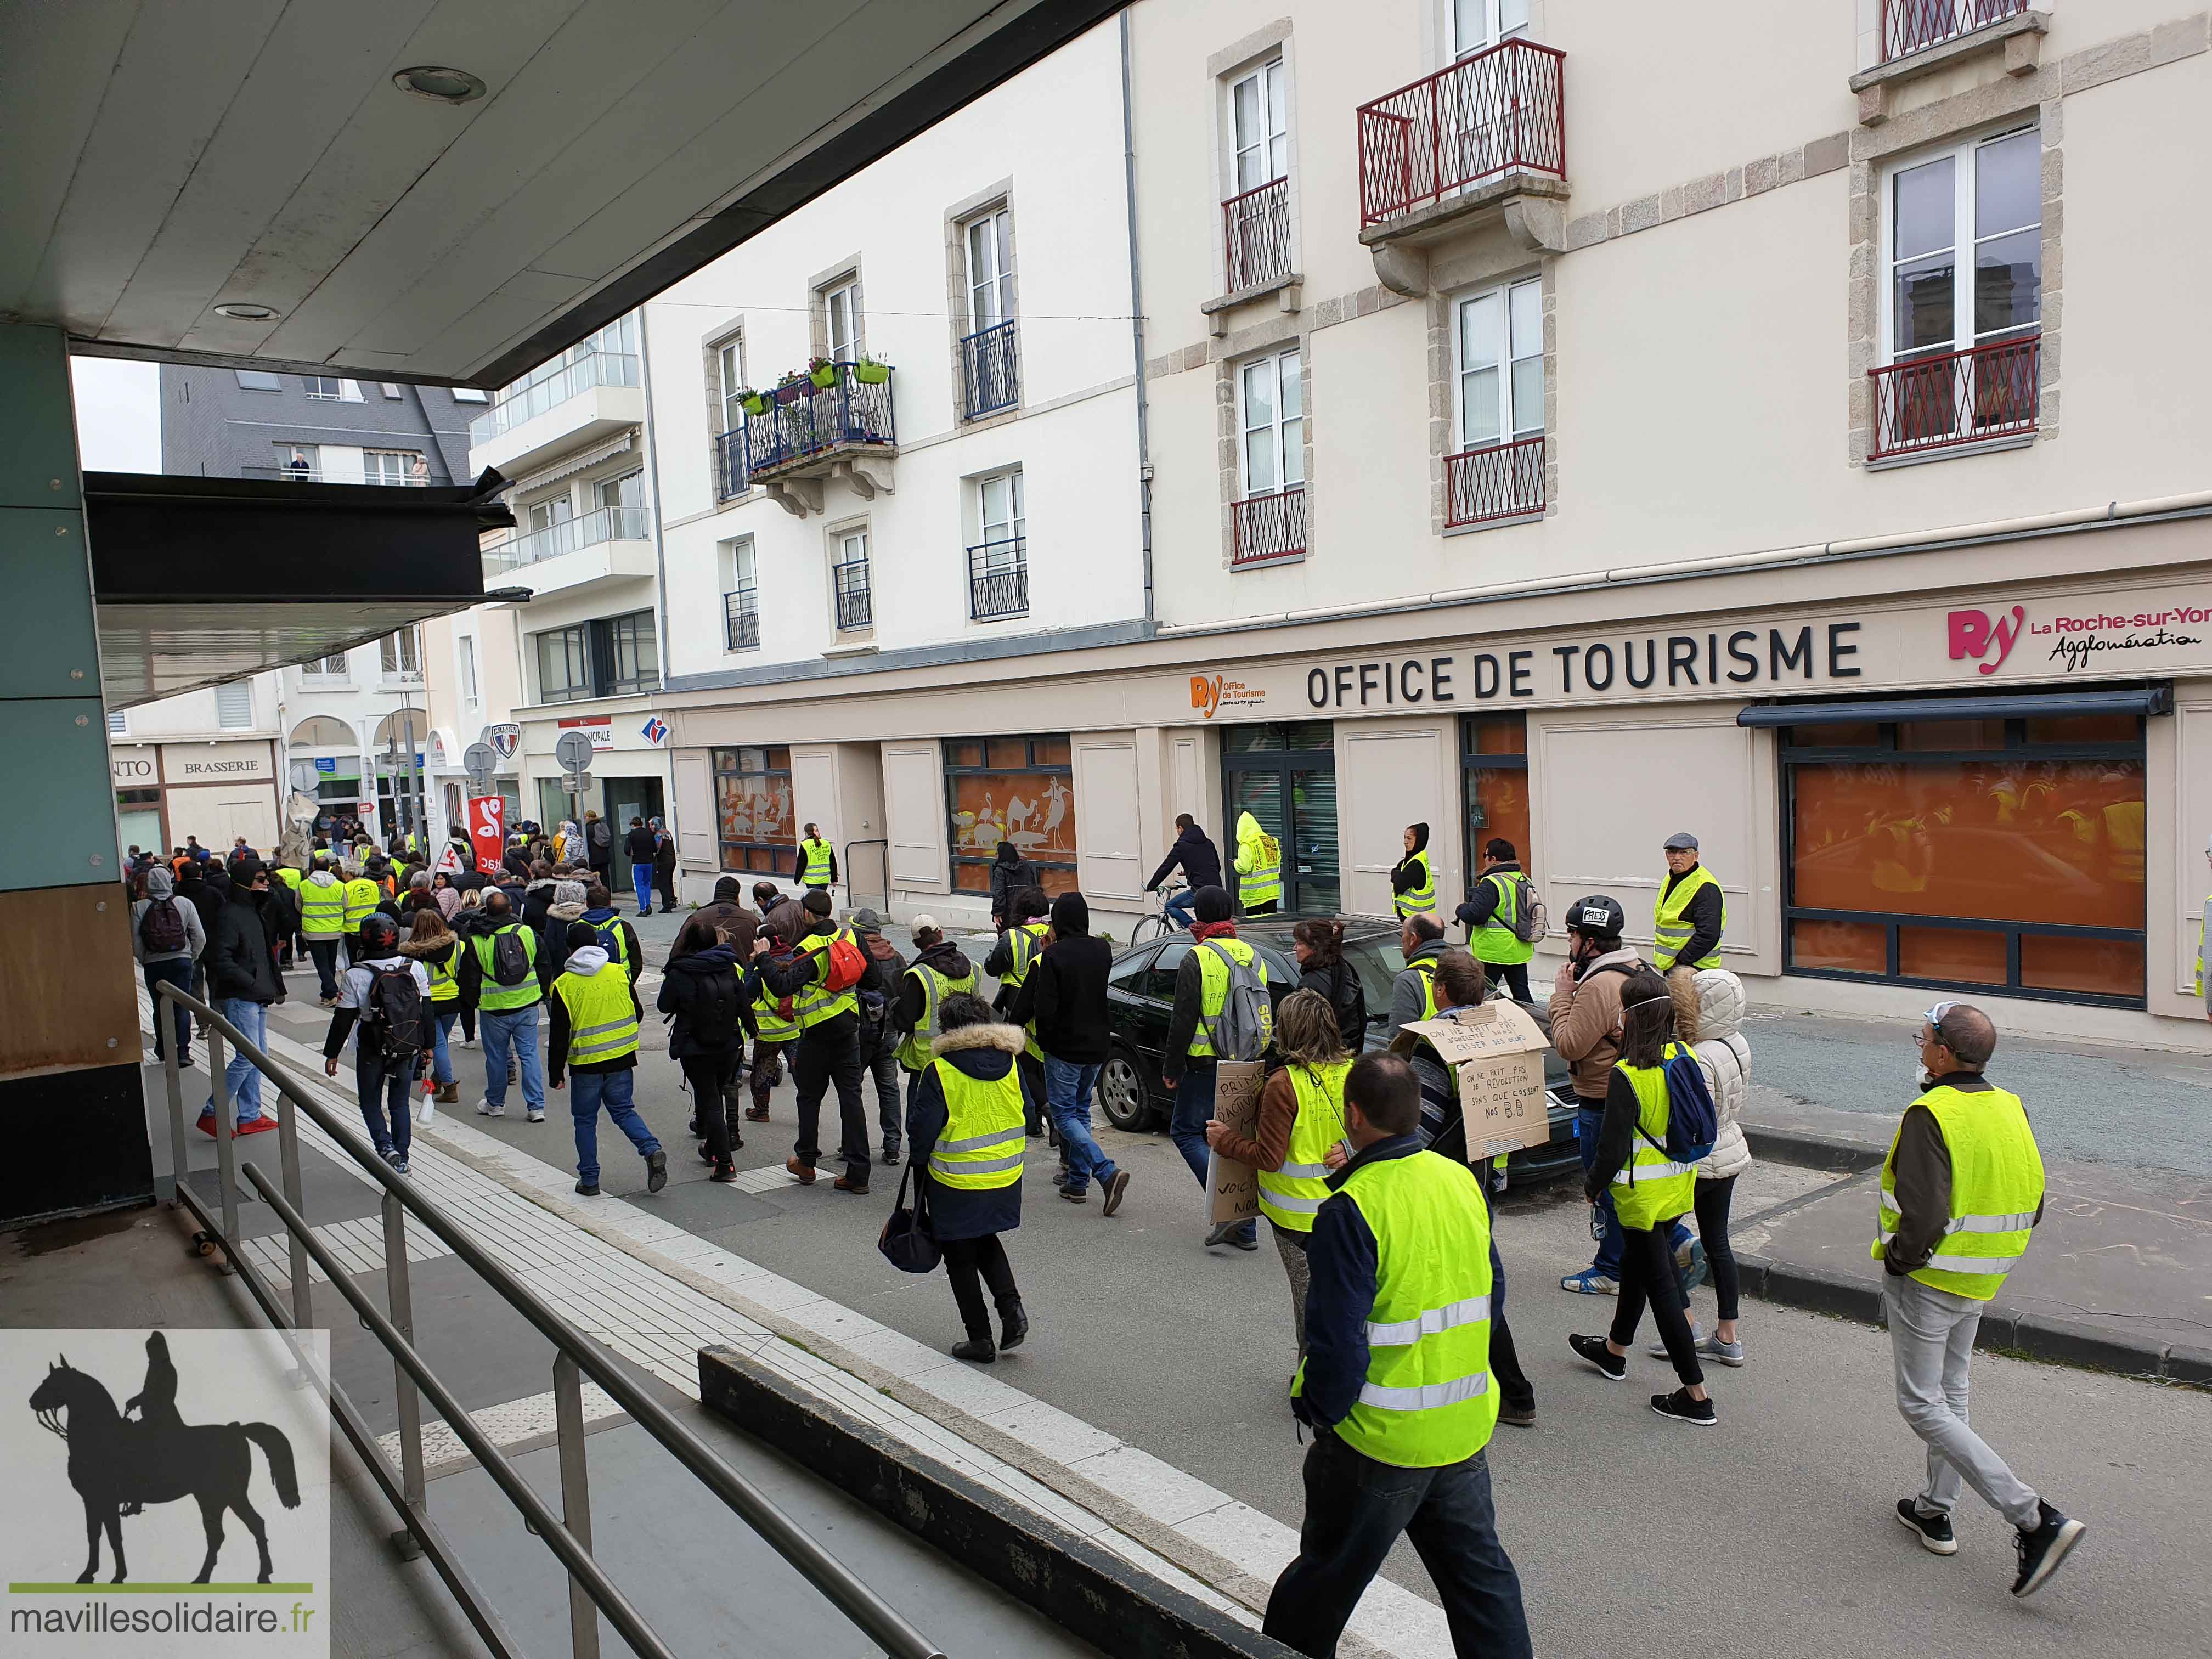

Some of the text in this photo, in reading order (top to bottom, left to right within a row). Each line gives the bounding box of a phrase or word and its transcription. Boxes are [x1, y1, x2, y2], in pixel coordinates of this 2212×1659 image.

[2031, 623, 2051, 634] La
[1948, 605, 2024, 675] Ry
[2049, 629, 2202, 672] Agglomération
[1308, 622, 1861, 708] OFFICE DE TOURISME
[1223, 682, 1245, 690] Office
[1190, 675, 1222, 718] Ry
[1233, 690, 1265, 698] Tourisme
[583, 730, 610, 742] UNICIPALE
[184, 760, 258, 774] BRASSERIE
[1584, 909, 1607, 921] PRESS
[1430, 1019, 1516, 1039] ON NE FAIT PAS
[1457, 1041, 1488, 1051] CASSER
[1513, 1066, 1526, 1075] PAS
[1472, 1086, 1539, 1106] SANS QUE CASSENT
[1485, 1107, 1498, 1120] NOS
